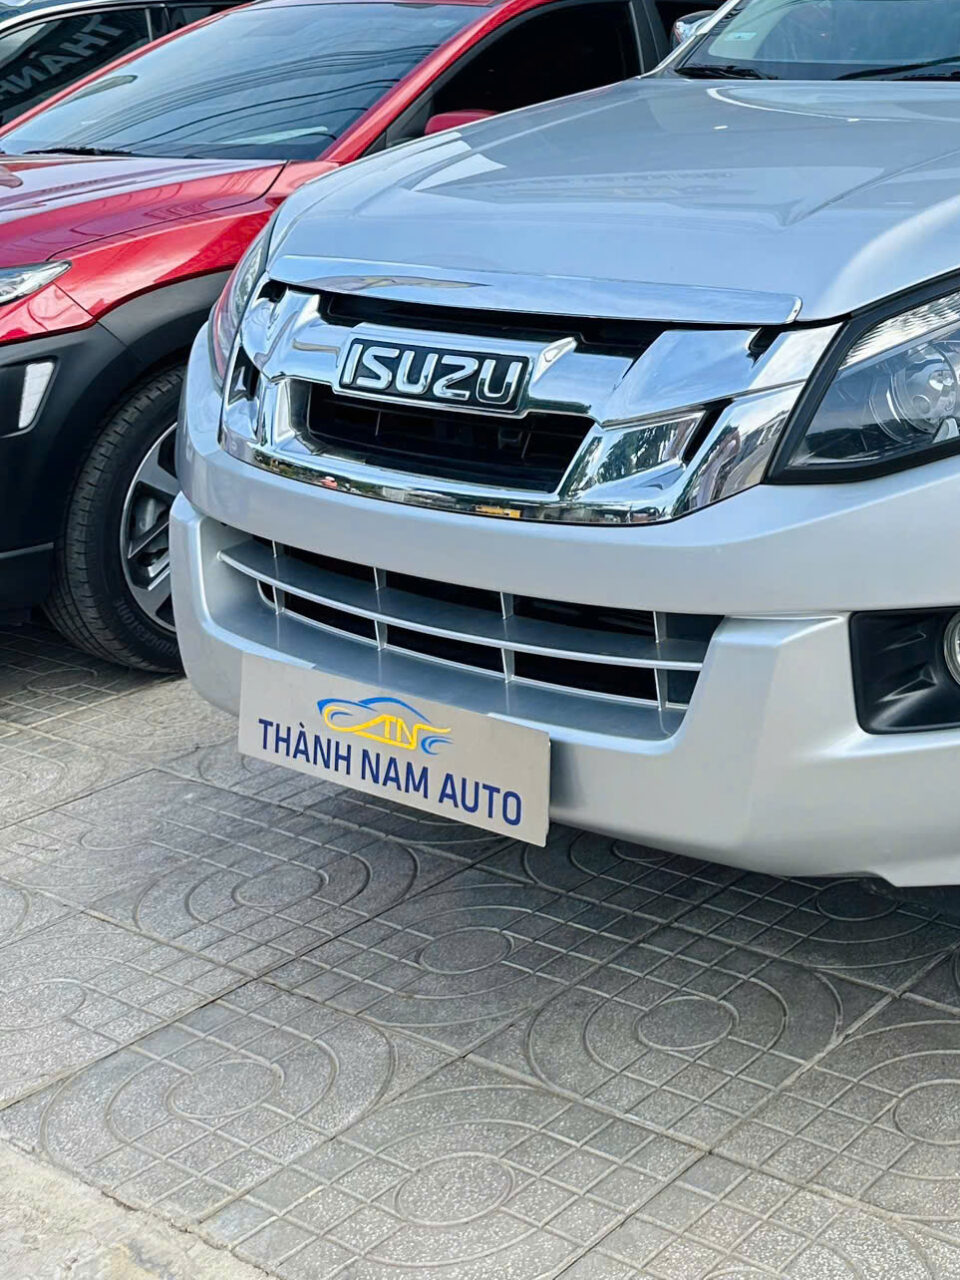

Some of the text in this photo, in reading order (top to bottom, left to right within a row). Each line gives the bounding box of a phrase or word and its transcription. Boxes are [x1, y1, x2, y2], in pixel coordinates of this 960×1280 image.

[341, 342, 524, 405] ISUZU
[258, 718, 522, 826] THÀNH NAM AUTO
